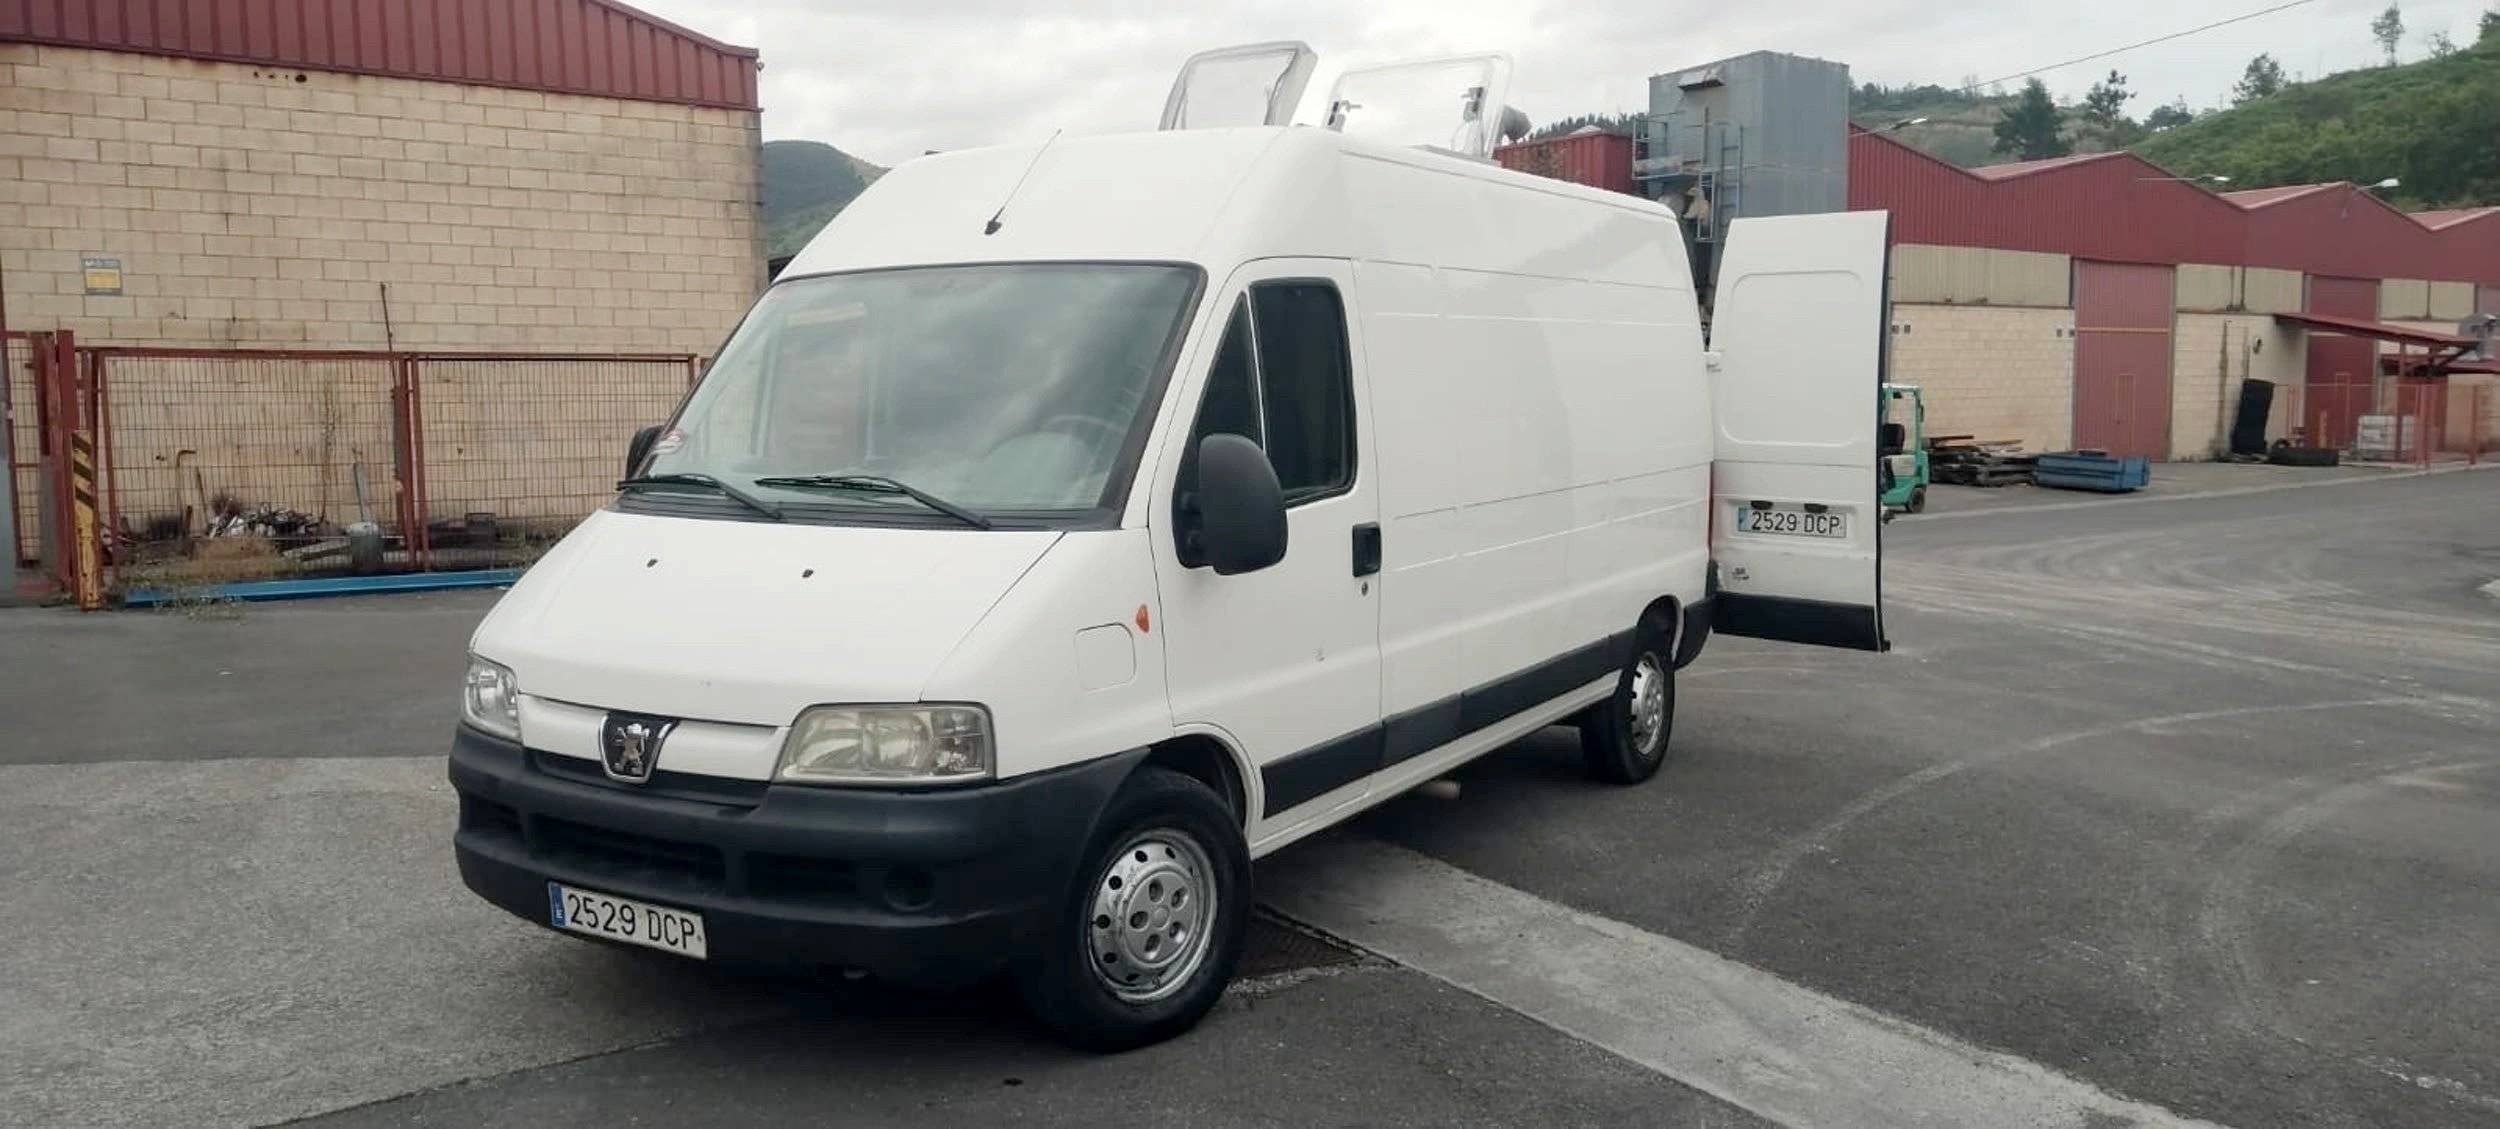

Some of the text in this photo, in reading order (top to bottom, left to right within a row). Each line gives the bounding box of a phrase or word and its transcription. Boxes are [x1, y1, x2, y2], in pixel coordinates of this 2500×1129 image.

[1751, 511, 1839, 534] 2529 DCP
[568, 893, 694, 949] 2529 DCP
